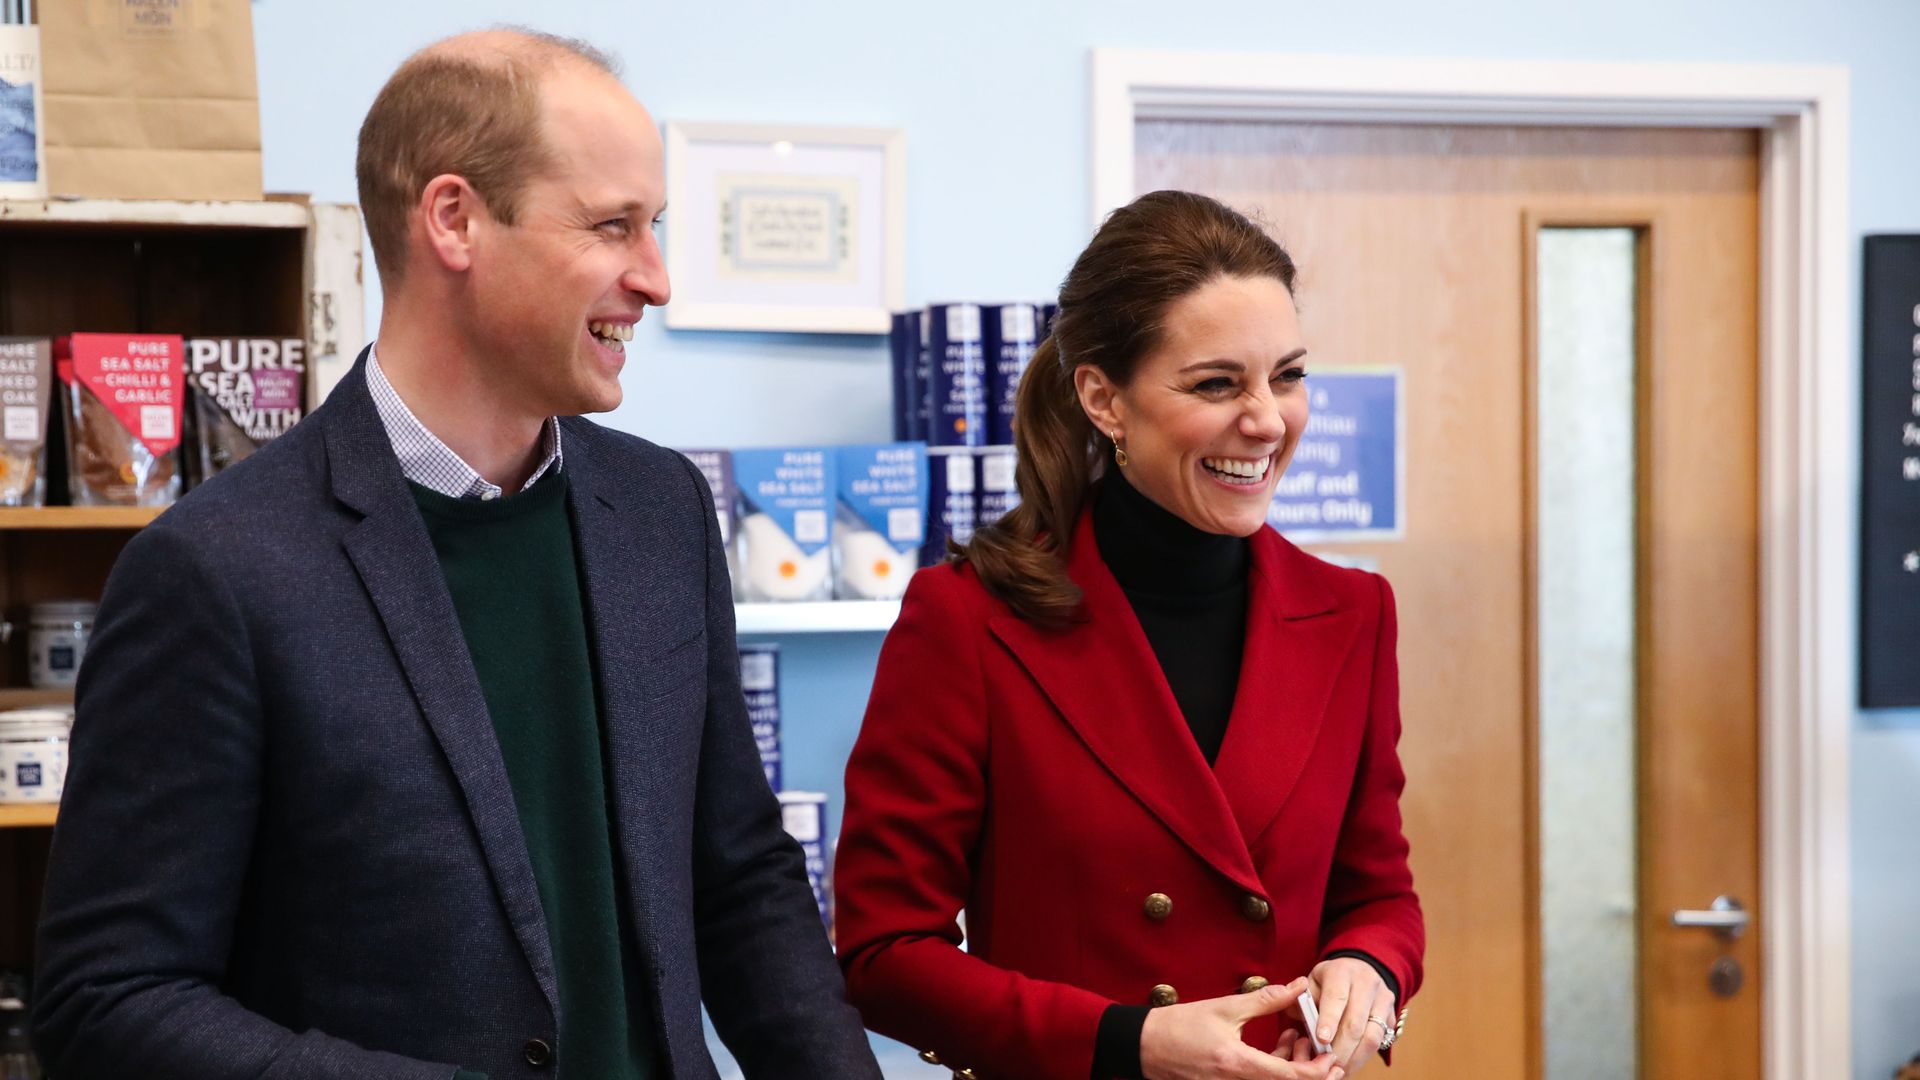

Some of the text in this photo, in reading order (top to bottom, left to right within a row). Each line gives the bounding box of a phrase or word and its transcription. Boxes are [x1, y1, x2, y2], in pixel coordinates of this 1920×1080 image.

[128, 342, 169, 355] PURE
[190, 339, 305, 372] PURE
[101, 357, 170, 371] SEA SALT
[105, 373, 156, 387] CHILLI
[160, 373, 171, 387] &
[200, 373, 255, 395] SEA
[3, 391, 37, 404] OAK
[115, 389, 172, 403] GARLIC
[230, 407, 301, 431] WITH
[783, 451, 823, 465] PURE
[876, 450, 915, 463] PURE
[758, 480, 824, 495] SEA SALT
[852, 479, 917, 494] SEA SALT
[1318, 472, 1359, 496] and
[1322, 499, 1372, 526] Only
